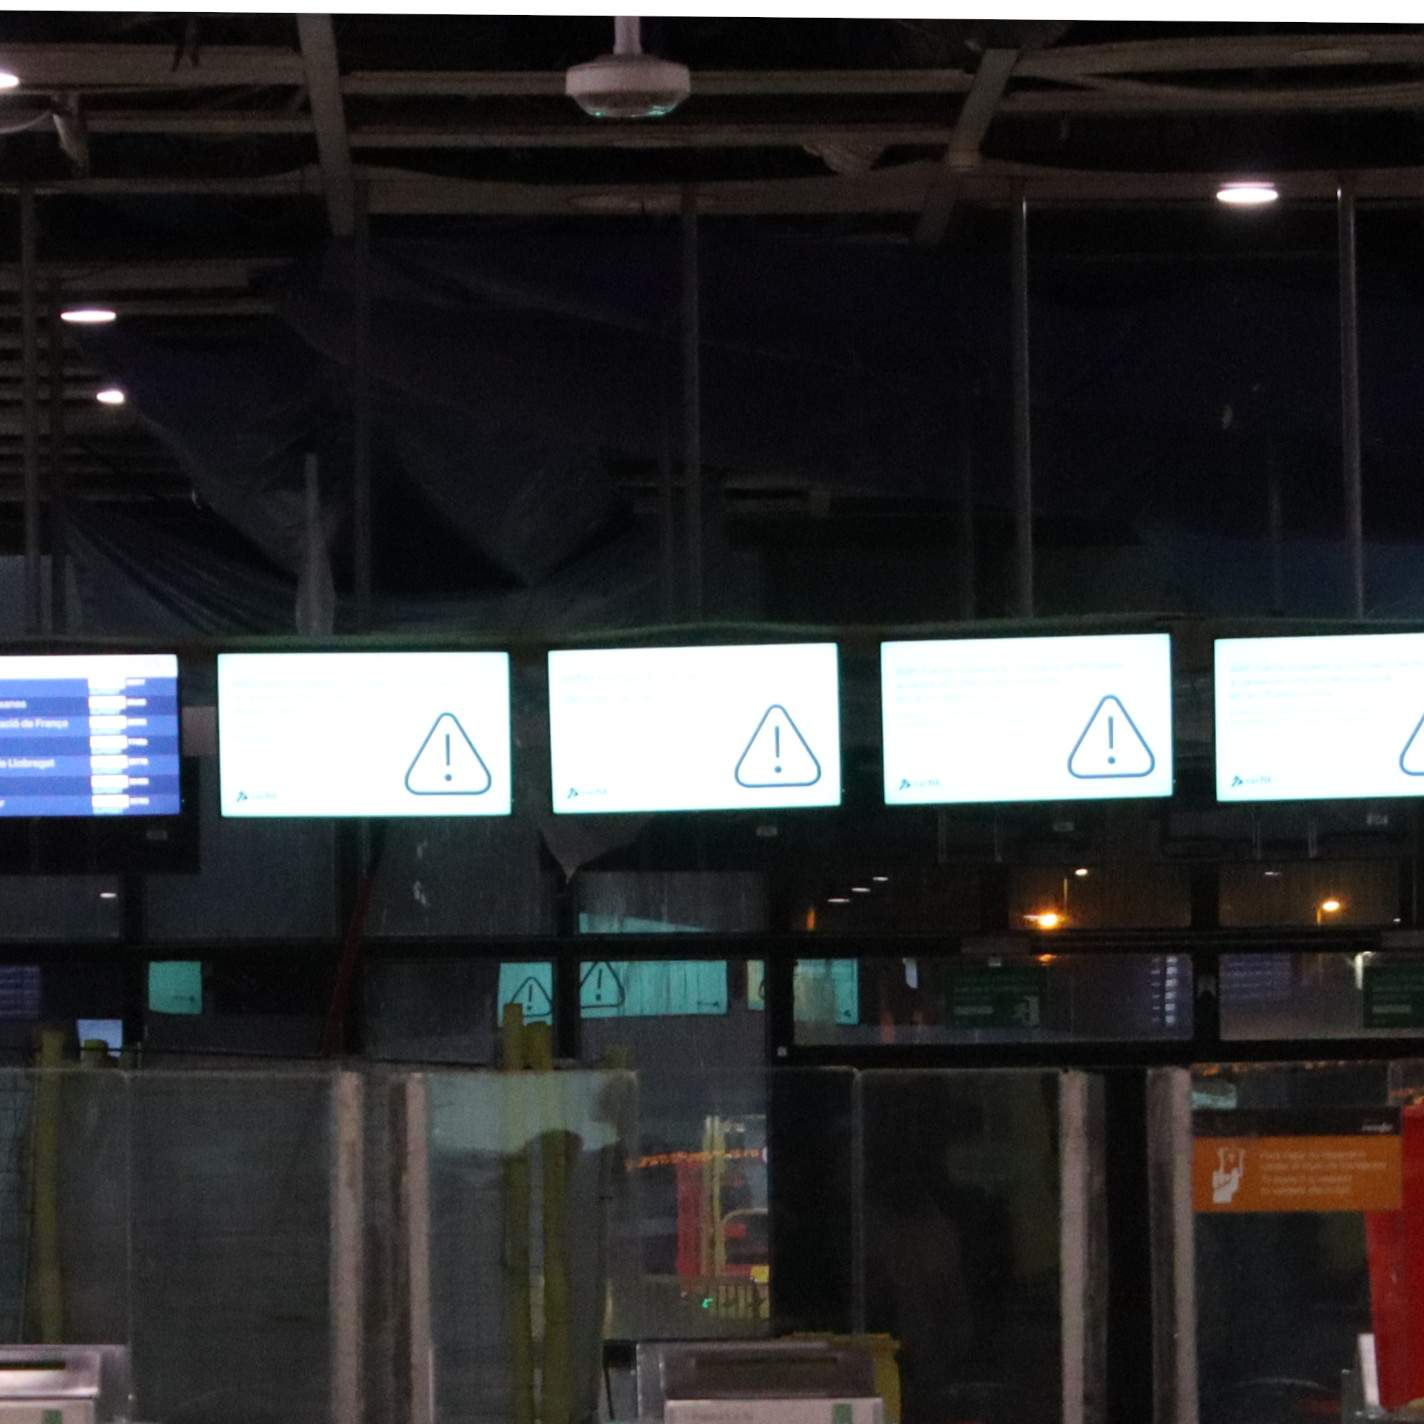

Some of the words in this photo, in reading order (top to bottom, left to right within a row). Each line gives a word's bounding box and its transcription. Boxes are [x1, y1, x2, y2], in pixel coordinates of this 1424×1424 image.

[21, 719, 34, 729] de
[35, 719, 69, 731] França
[8, 759, 55, 770] Llobregat
